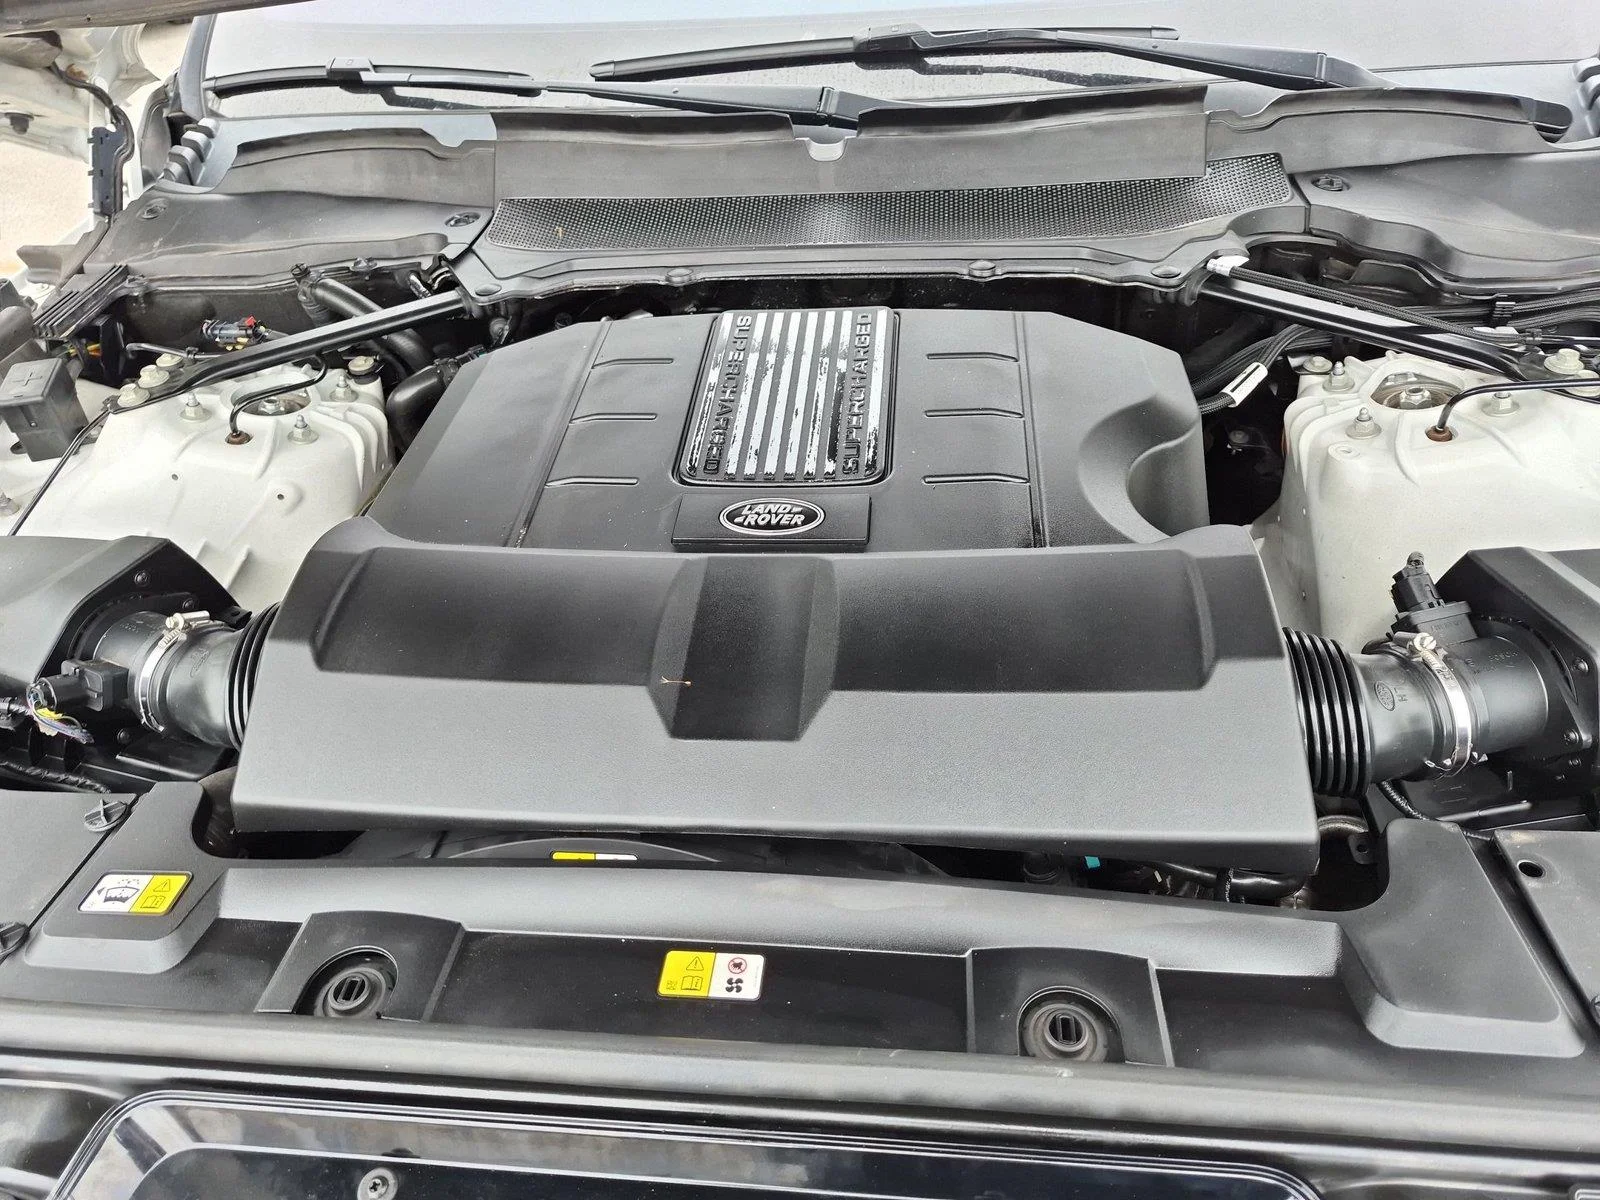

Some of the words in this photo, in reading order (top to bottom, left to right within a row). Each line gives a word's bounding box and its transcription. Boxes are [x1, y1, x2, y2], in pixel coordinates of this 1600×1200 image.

[703, 315, 752, 474] SUPERCHARGED
[842, 313, 872, 475] SUPERCHARGED
[741, 504, 792, 515] LAND
[743, 514, 805, 526] ROVER
